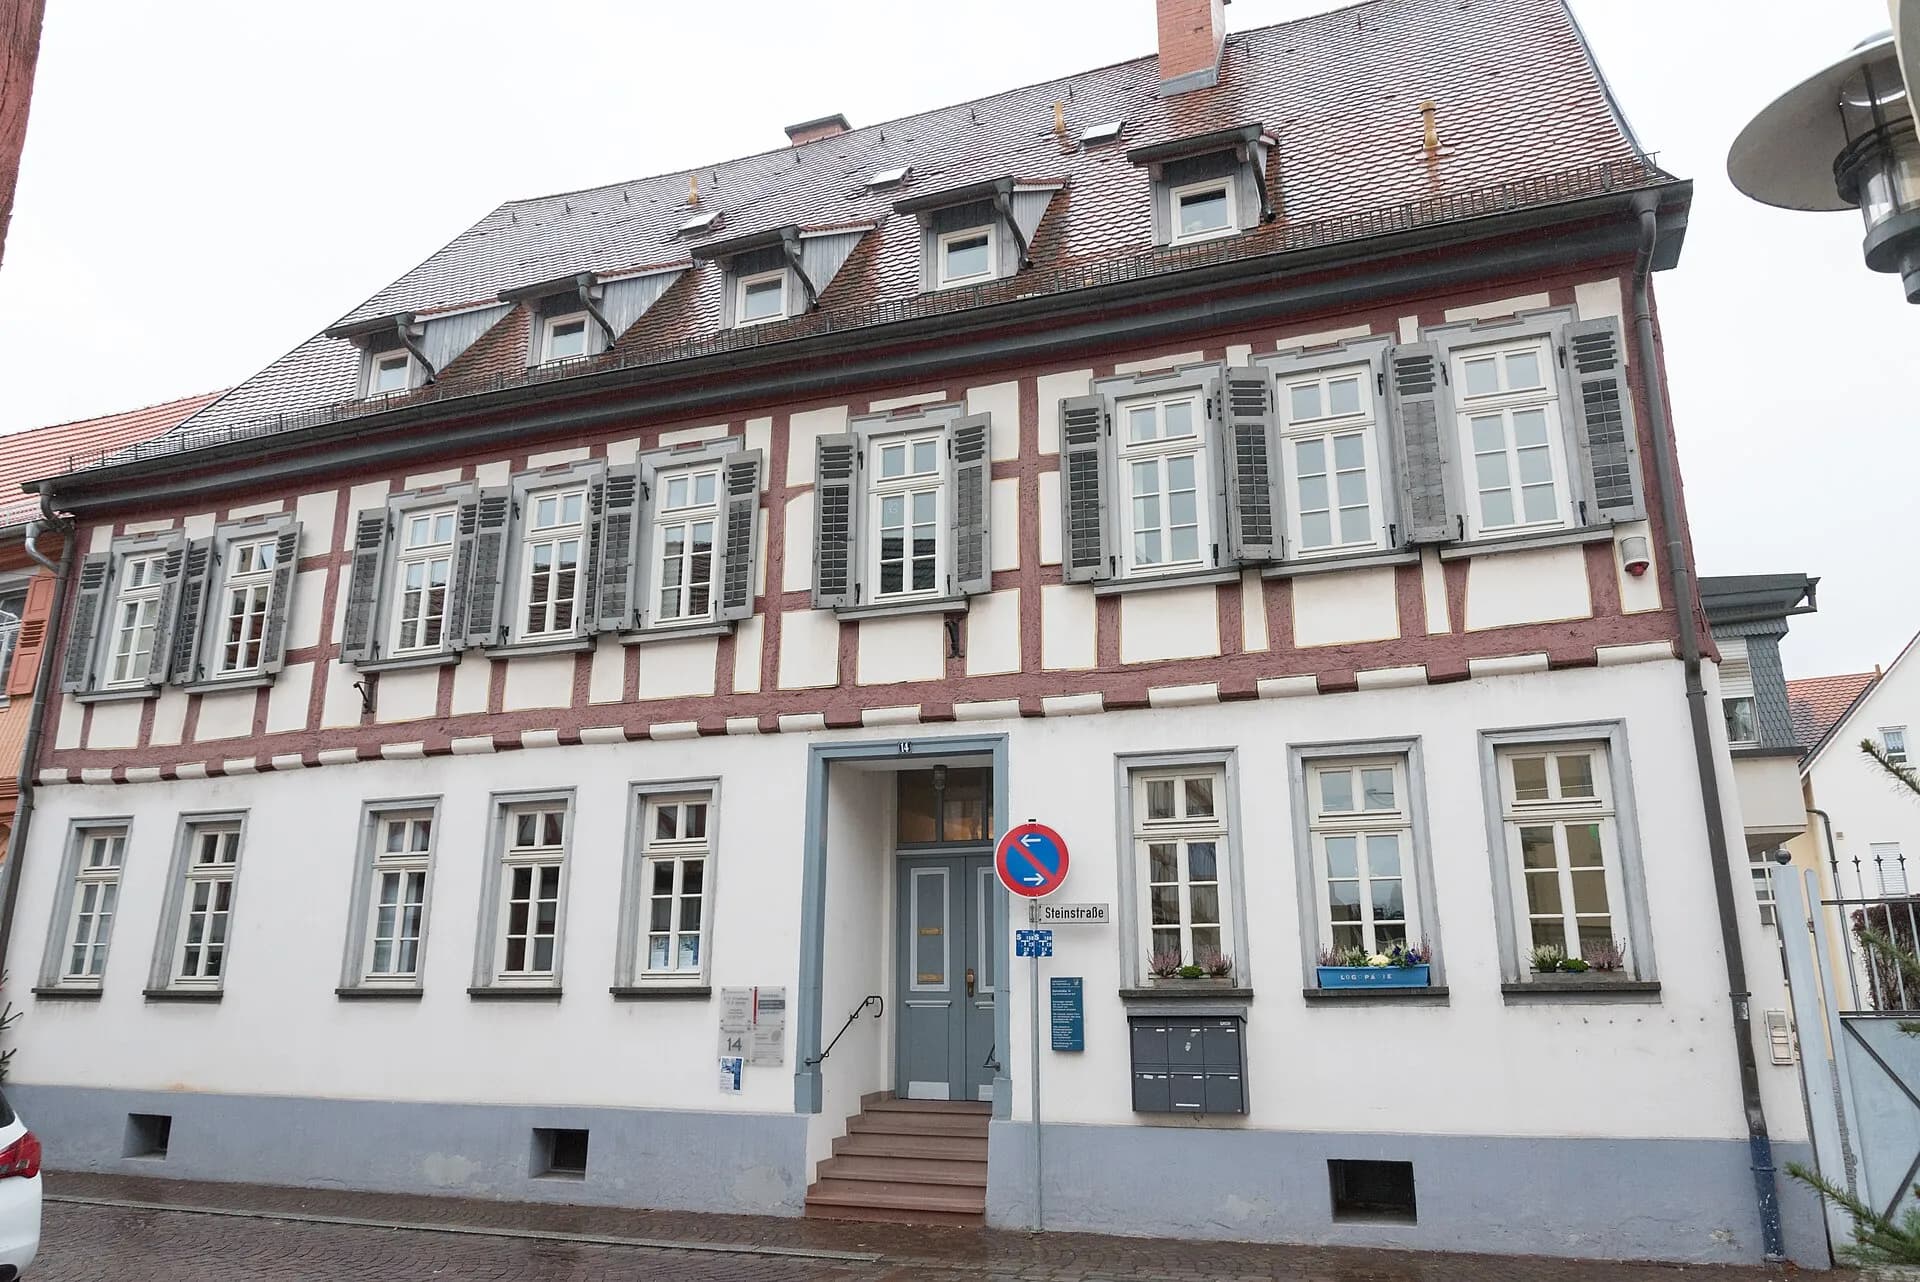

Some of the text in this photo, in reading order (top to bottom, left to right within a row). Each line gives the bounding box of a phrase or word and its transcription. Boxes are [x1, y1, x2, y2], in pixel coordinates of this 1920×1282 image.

[900, 742, 910, 752] 14
[1045, 907, 1104, 919] Steinstraße
[727, 1037, 742, 1051] 14
